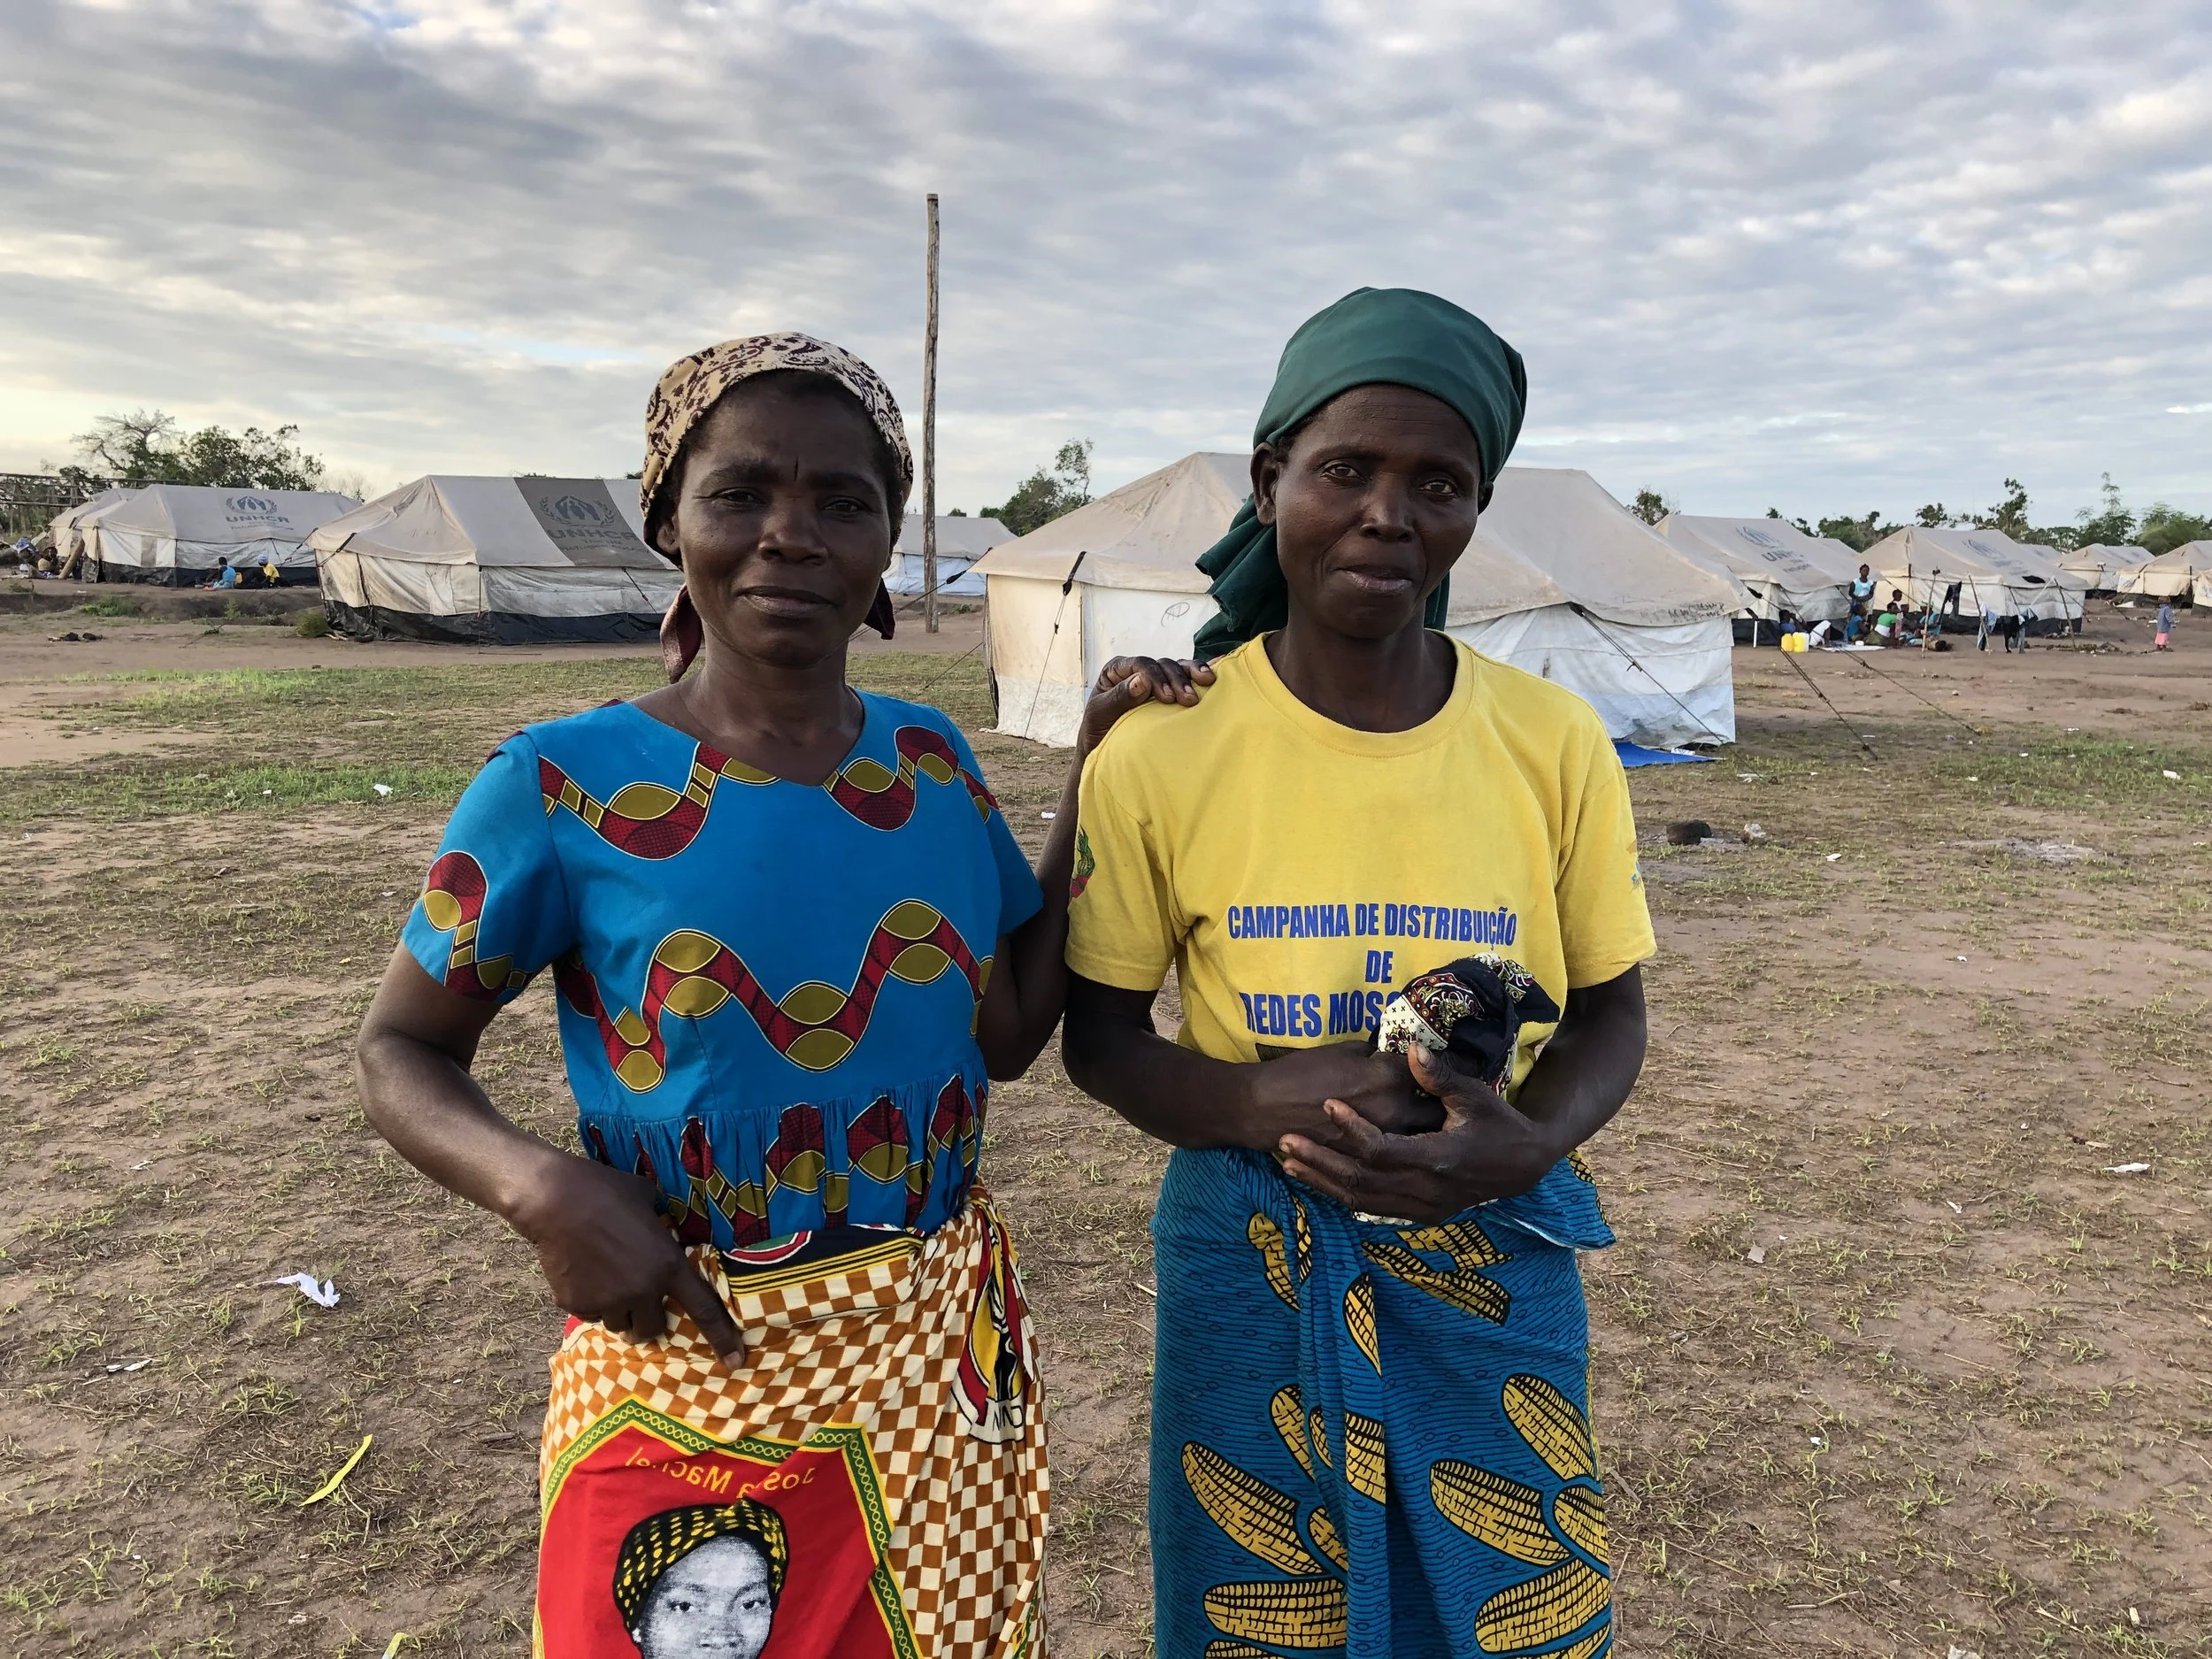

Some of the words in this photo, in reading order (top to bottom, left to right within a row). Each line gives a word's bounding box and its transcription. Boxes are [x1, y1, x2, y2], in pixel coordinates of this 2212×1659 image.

[546, 528, 638, 541] UNHCR
[1227, 903, 1351, 940] CAMPANHA
[1355, 902, 1379, 936] DE
[1384, 903, 1517, 951] DISTRIBUIÇÃO
[1364, 949, 1394, 984] DE
[1328, 989, 1402, 1036] MOS
